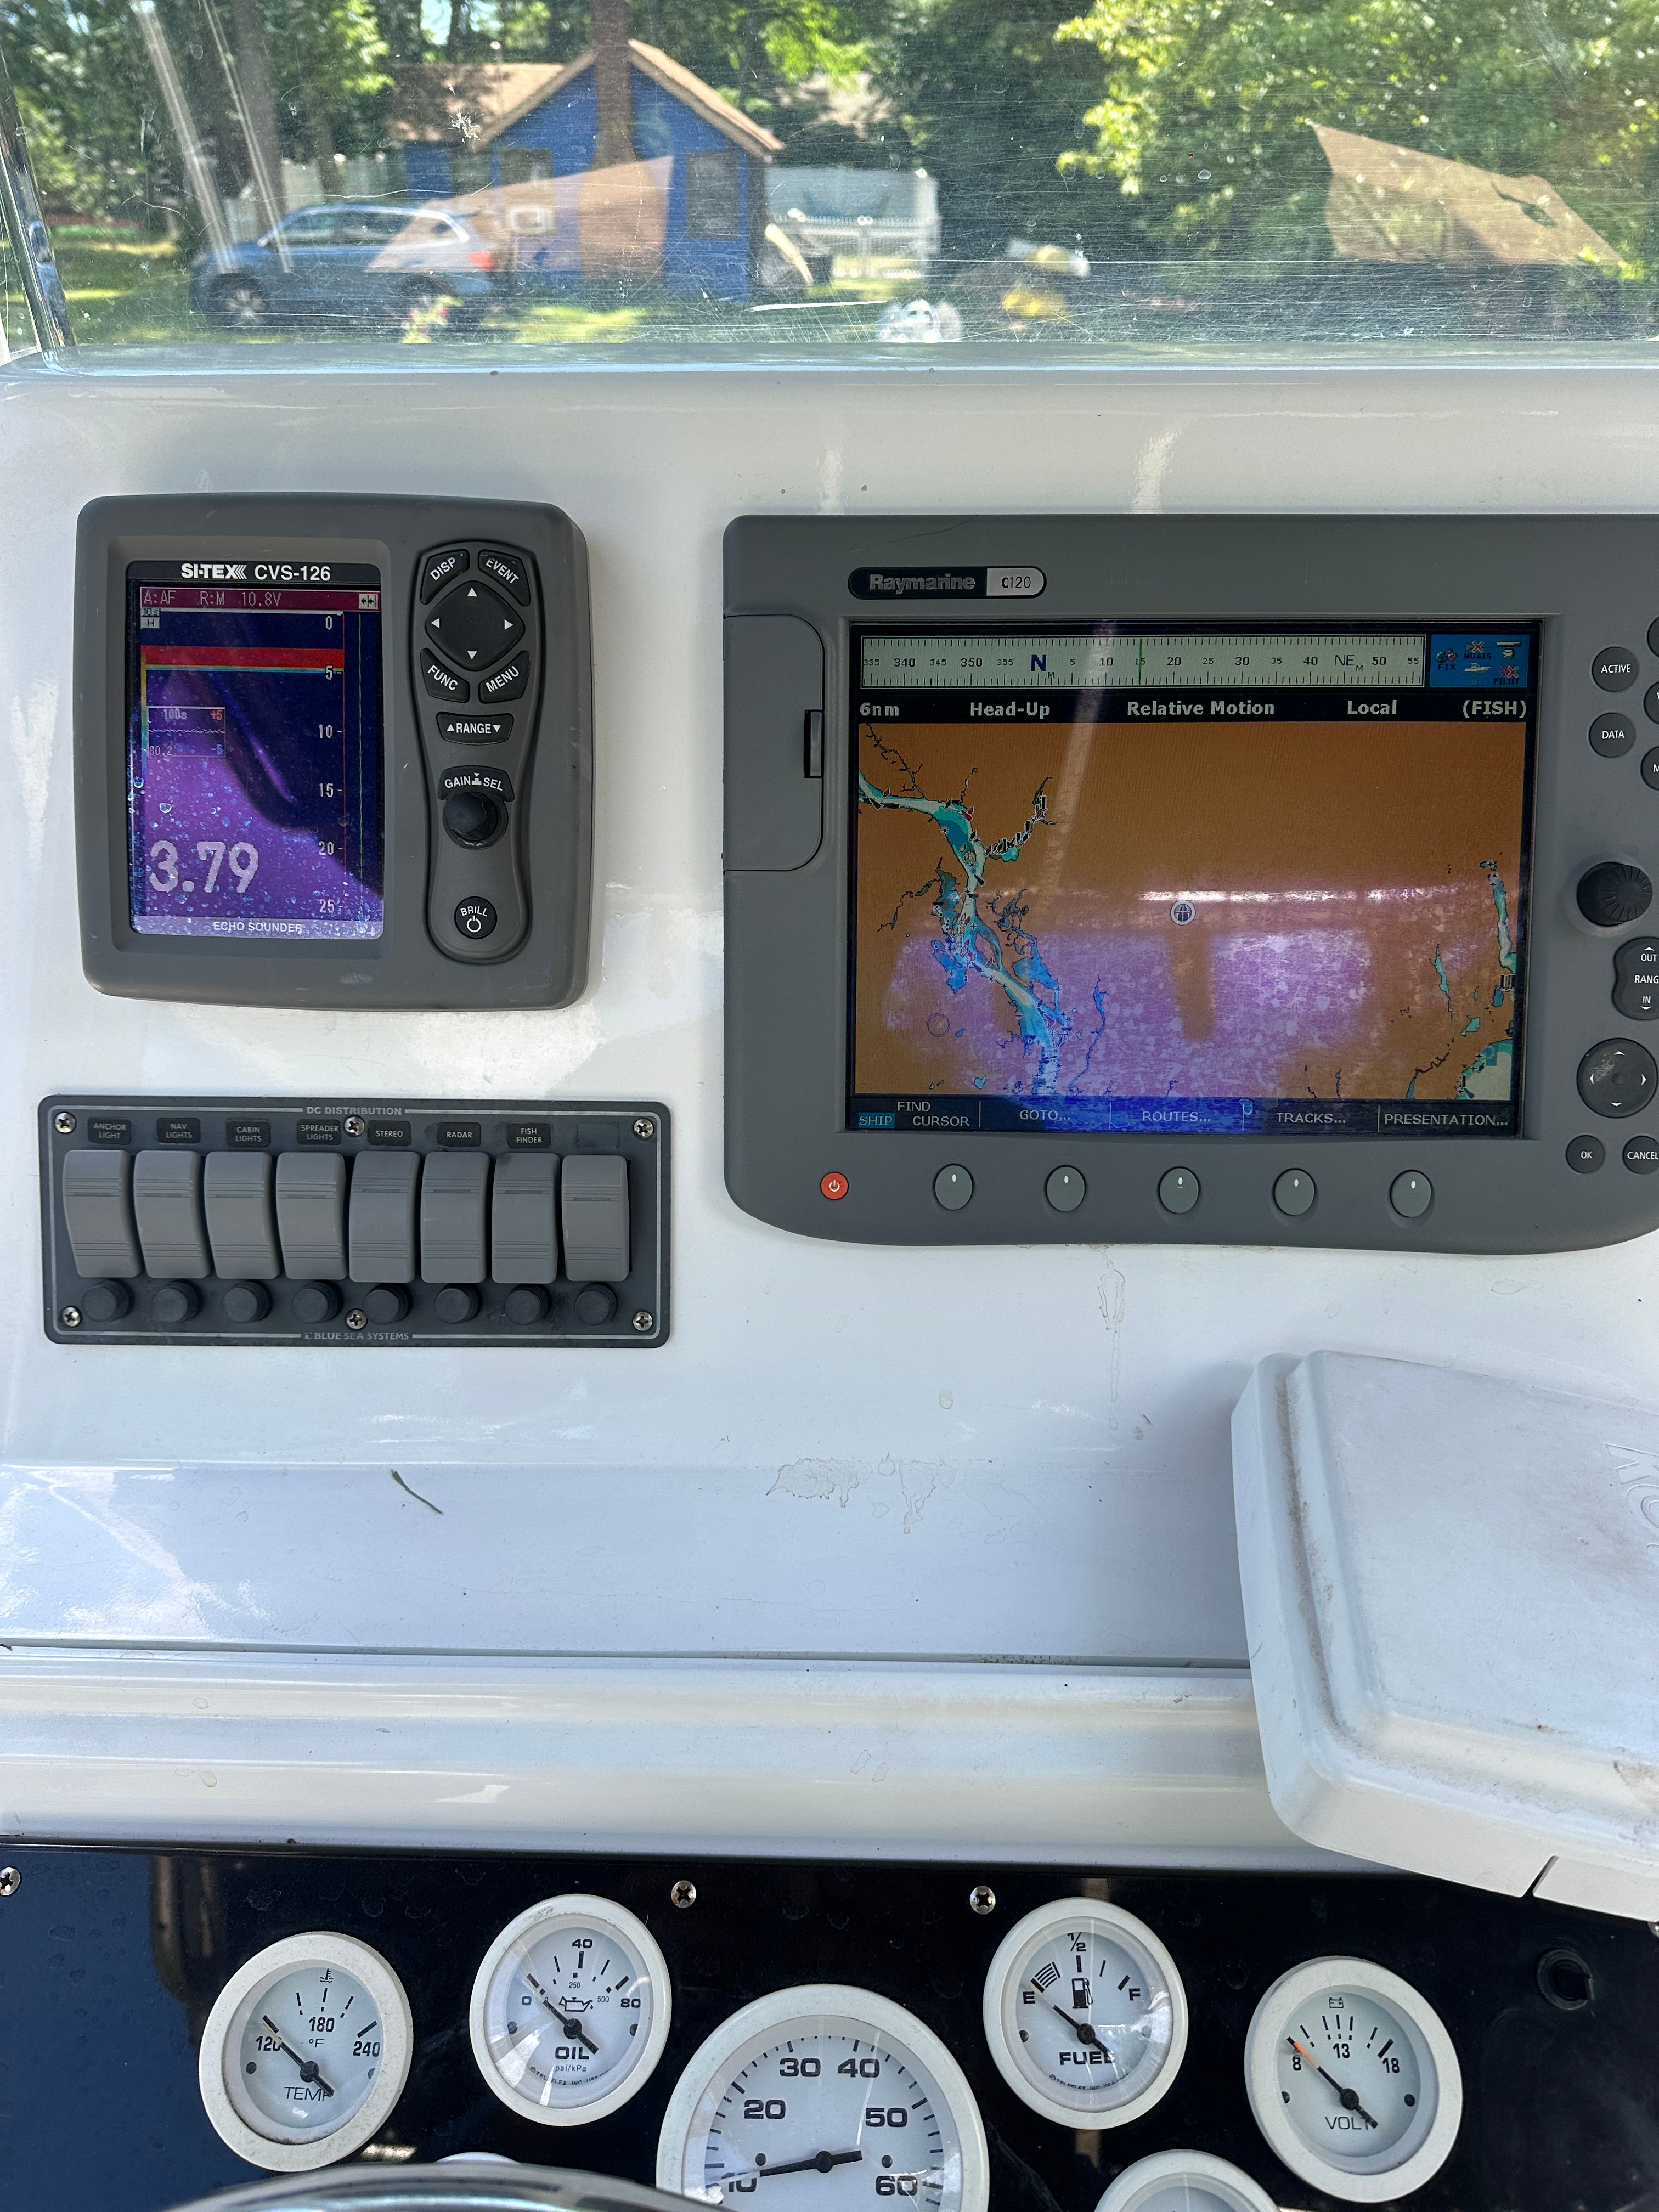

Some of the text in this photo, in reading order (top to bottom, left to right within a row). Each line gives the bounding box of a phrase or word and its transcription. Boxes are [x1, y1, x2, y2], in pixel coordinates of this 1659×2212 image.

[255, 566, 330, 581] CVS-126
[430, 557, 456, 581] DISP
[486, 558, 520, 584] EVENT
[870, 573, 975, 594] Raymarine
[241, 591, 281, 607] 10.8V
[147, 619, 154, 627] H
[325, 616, 333, 630] 0
[894, 658, 916, 667] 340
[961, 658, 983, 667] 350
[1031, 654, 1047, 672] N
[1099, 657, 1113, 667] 10
[1167, 657, 1181, 665] 20
[1235, 657, 1249, 665] 30
[1303, 656, 1318, 665] 40
[1335, 654, 1355, 666] NE
[1372, 656, 1386, 665] 50
[1601, 664, 1631, 674] ACTIVE
[325, 665, 334, 680] 5
[427, 664, 458, 691] FUNC
[485, 665, 520, 693] MENU
[860, 700, 1527, 719] 6nm Head-Up Relative Motion Local (FISH)
[318, 724, 334, 738] 10
[456, 723, 492, 734] RANGE
[1602, 730, 1624, 740] DATA
[319, 783, 334, 797] 15
[444, 776, 503, 791] GAIN SEL
[318, 841, 334, 856] 20
[149, 840, 258, 894] 3.79
[319, 899, 335, 913] 25
[460, 906, 488, 917] BRILL
[213, 921, 303, 933] ECHO SOUNDER
[1640, 953, 1657, 962] OUT
[1634, 974, 1659, 984] RANG
[307, 1107, 402, 1115] DC DISTRIBUTION
[897, 1101, 931, 1111] FIND
[859, 1115, 970, 1127] SHIP CURSOR
[1019, 1110, 1070, 1121] GOTO...
[1142, 1111, 1210, 1122] ROUTES...
[1277, 1113, 1346, 1124] TRACKS...
[1384, 1113, 1508, 1126] PRESENTATION...
[93, 1122, 127, 1131] ANCHOR
[236, 1126, 261, 1134] CABIN
[301, 1124, 340, 1133] SPREADER
[520, 1127, 538, 1136] FISH
[98, 1131, 121, 1139] LIGHT
[166, 1131, 193, 1139] LIGHTS
[235, 1134, 262, 1142] LIGHTS
[307, 1133, 334, 1141] LIGHTS
[375, 1130, 403, 1138] STEREO
[446, 1131, 472, 1139] RADAR
[516, 1136, 543, 1144] FINDER
[1581, 1151, 1593, 1159] OK
[1627, 1152, 1659, 1160] CANCEL
[572, 1939, 592, 1948] 40
[521, 1996, 532, 2006] 0
[1023, 1991, 1035, 2004] E
[1128, 1988, 1141, 2001] F
[620, 1998, 641, 2008] 80
[309, 2017, 335, 2033] 180
[256, 2036, 281, 2052] 120
[353, 2041, 380, 2057] 240
[1333, 2043, 1350, 2058] 13
[555, 2046, 589, 2060] OIL
[1059, 2051, 1113, 2065] FUEL
[555, 2064, 586, 2073] psi/kPa
[780, 2058, 821, 2078] 30
[837, 2058, 880, 2078] 40
[1292, 2055, 1302, 2072] 8
[1383, 2058, 1400, 2073] 18
[743, 2100, 786, 2119] 20
[866, 2108, 907, 2128] 50
[721, 2172, 757, 2192] 10
[876, 2175, 918, 2196] 60
